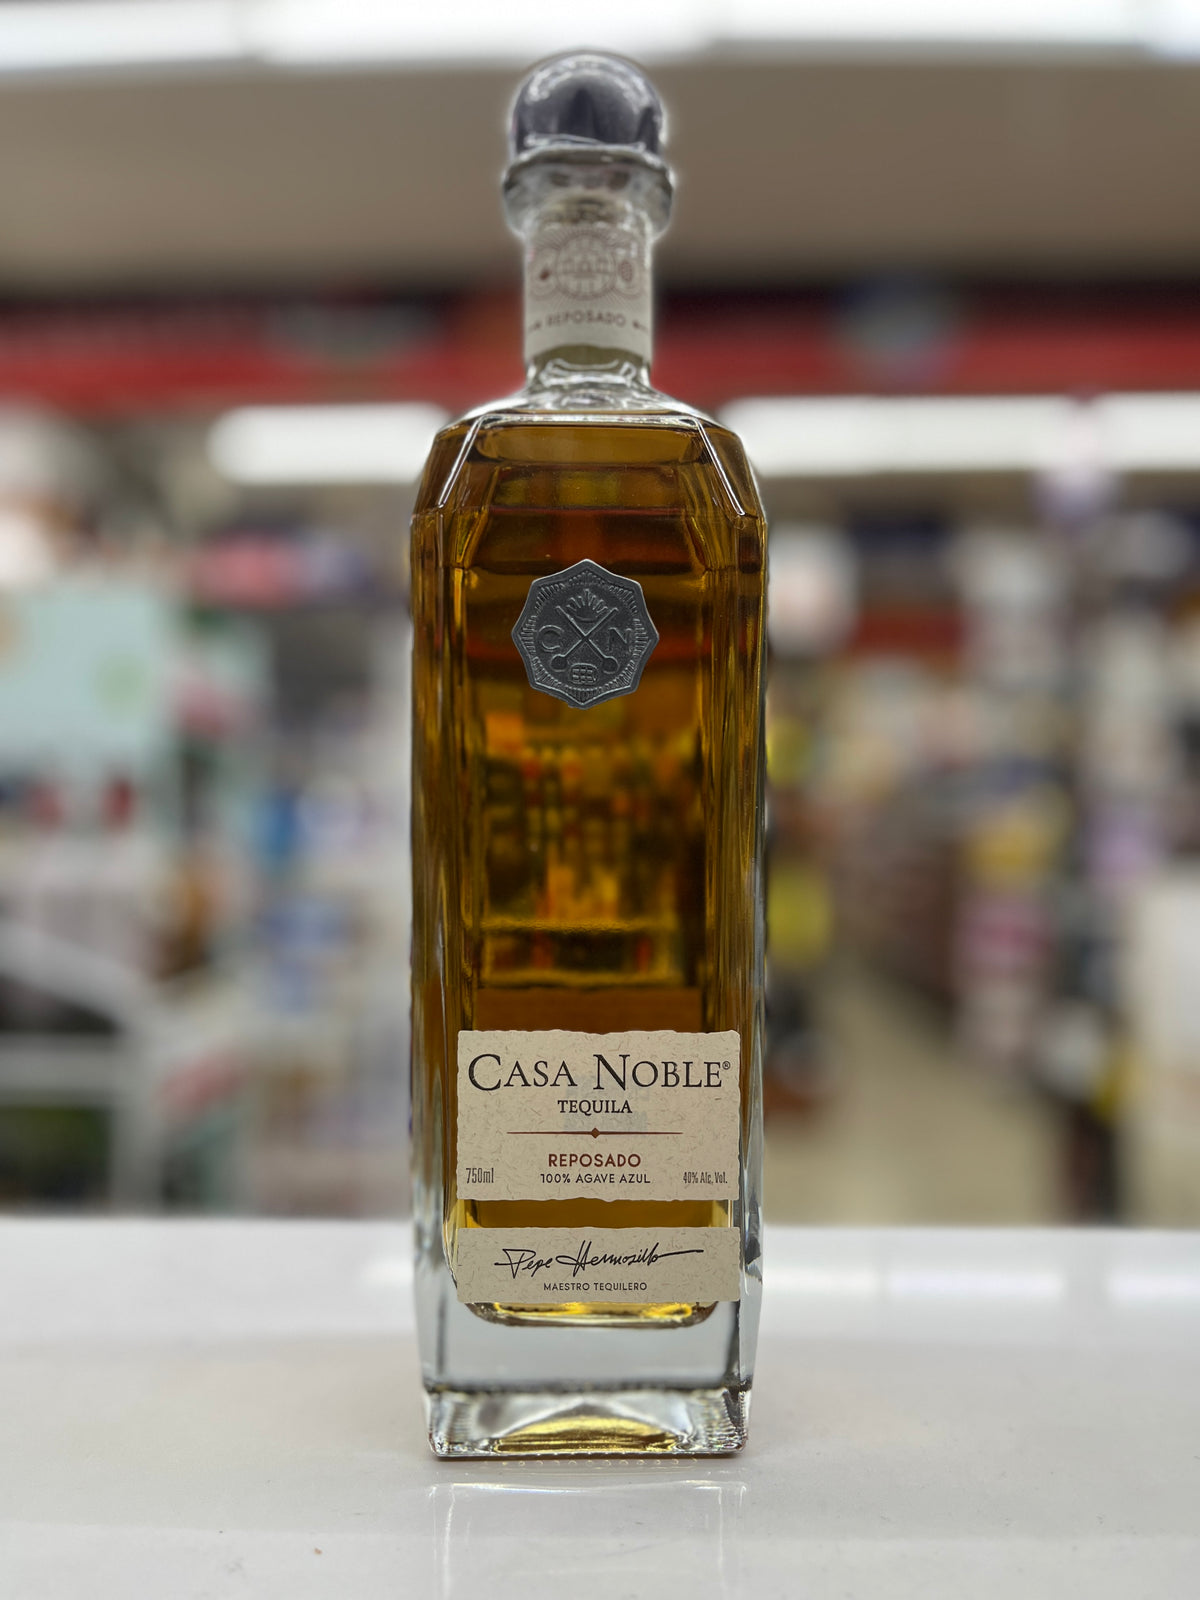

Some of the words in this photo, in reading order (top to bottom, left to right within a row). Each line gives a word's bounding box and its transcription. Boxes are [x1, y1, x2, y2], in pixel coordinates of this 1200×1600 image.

[546, 310, 626, 328] REPOSADO
[468, 1053, 578, 1091] CASA
[557, 1100, 633, 1116] TEQUILA
[548, 1153, 641, 1168] REPOSADO
[466, 1167, 495, 1184] 750ml
[540, 1173, 571, 1184] 100%
[575, 1173, 615, 1184] AGAVE
[619, 1173, 650, 1184] AZUL
[683, 1171, 699, 1184] 40%
[494, 1248, 552, 1278] Pepe
[543, 1282, 590, 1291] MAESTRO
[593, 1282, 648, 1291] TEQUILERO
